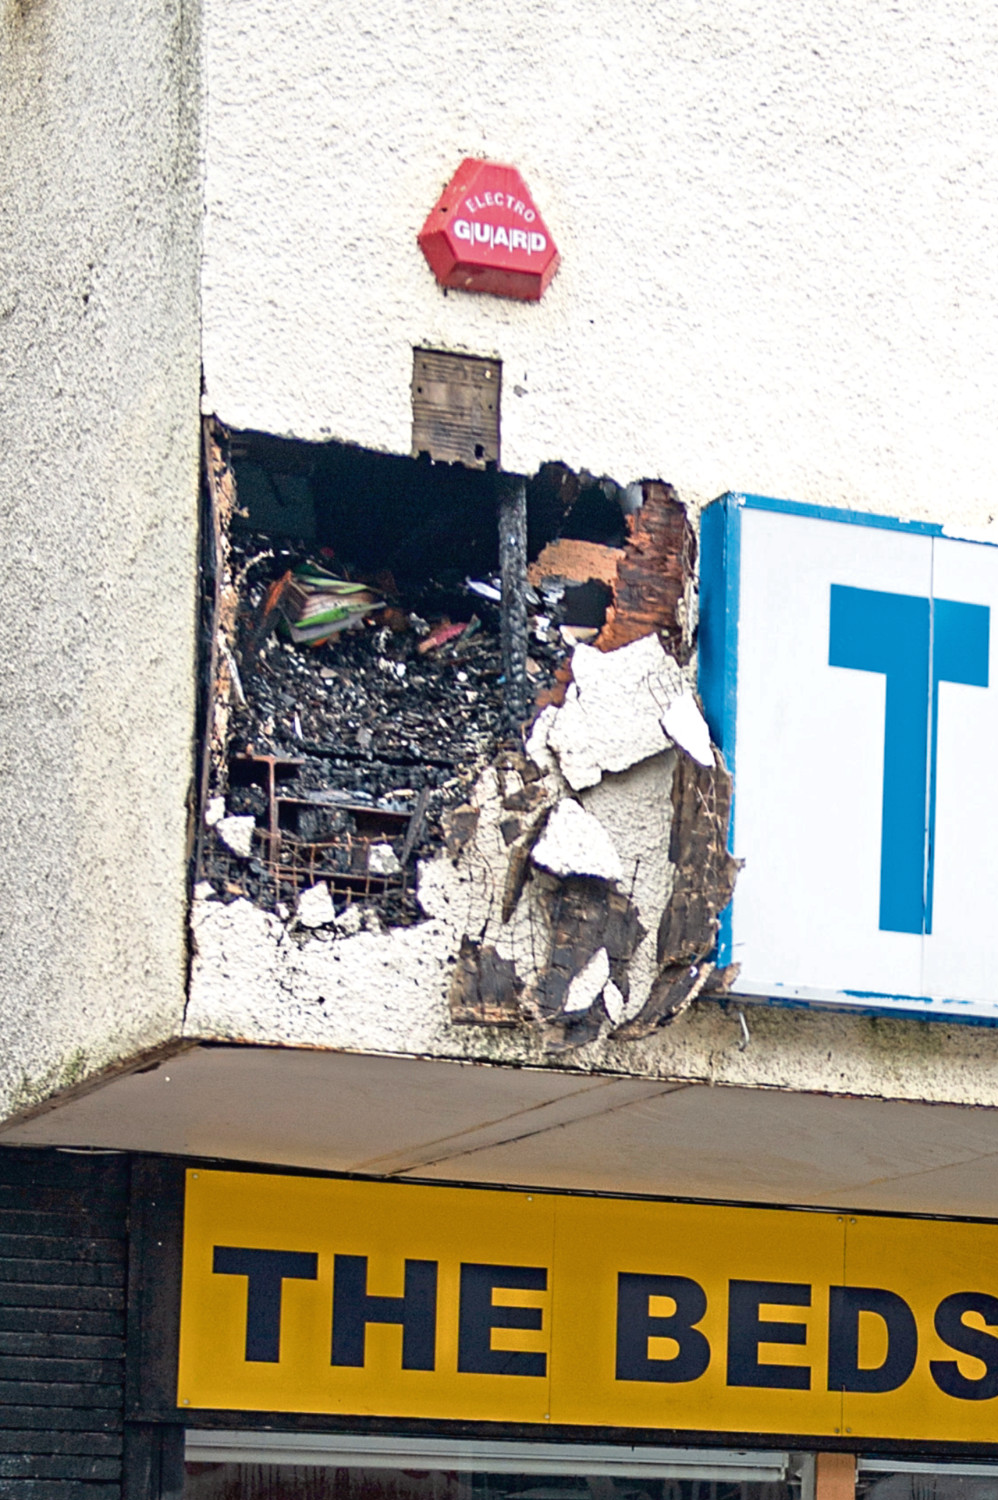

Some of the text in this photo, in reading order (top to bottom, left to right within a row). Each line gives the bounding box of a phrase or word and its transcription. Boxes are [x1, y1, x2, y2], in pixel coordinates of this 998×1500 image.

[465, 191, 536, 223] ELECTRO
[453, 220, 547, 254] GUARD
[213, 1246, 547, 1377] THE
